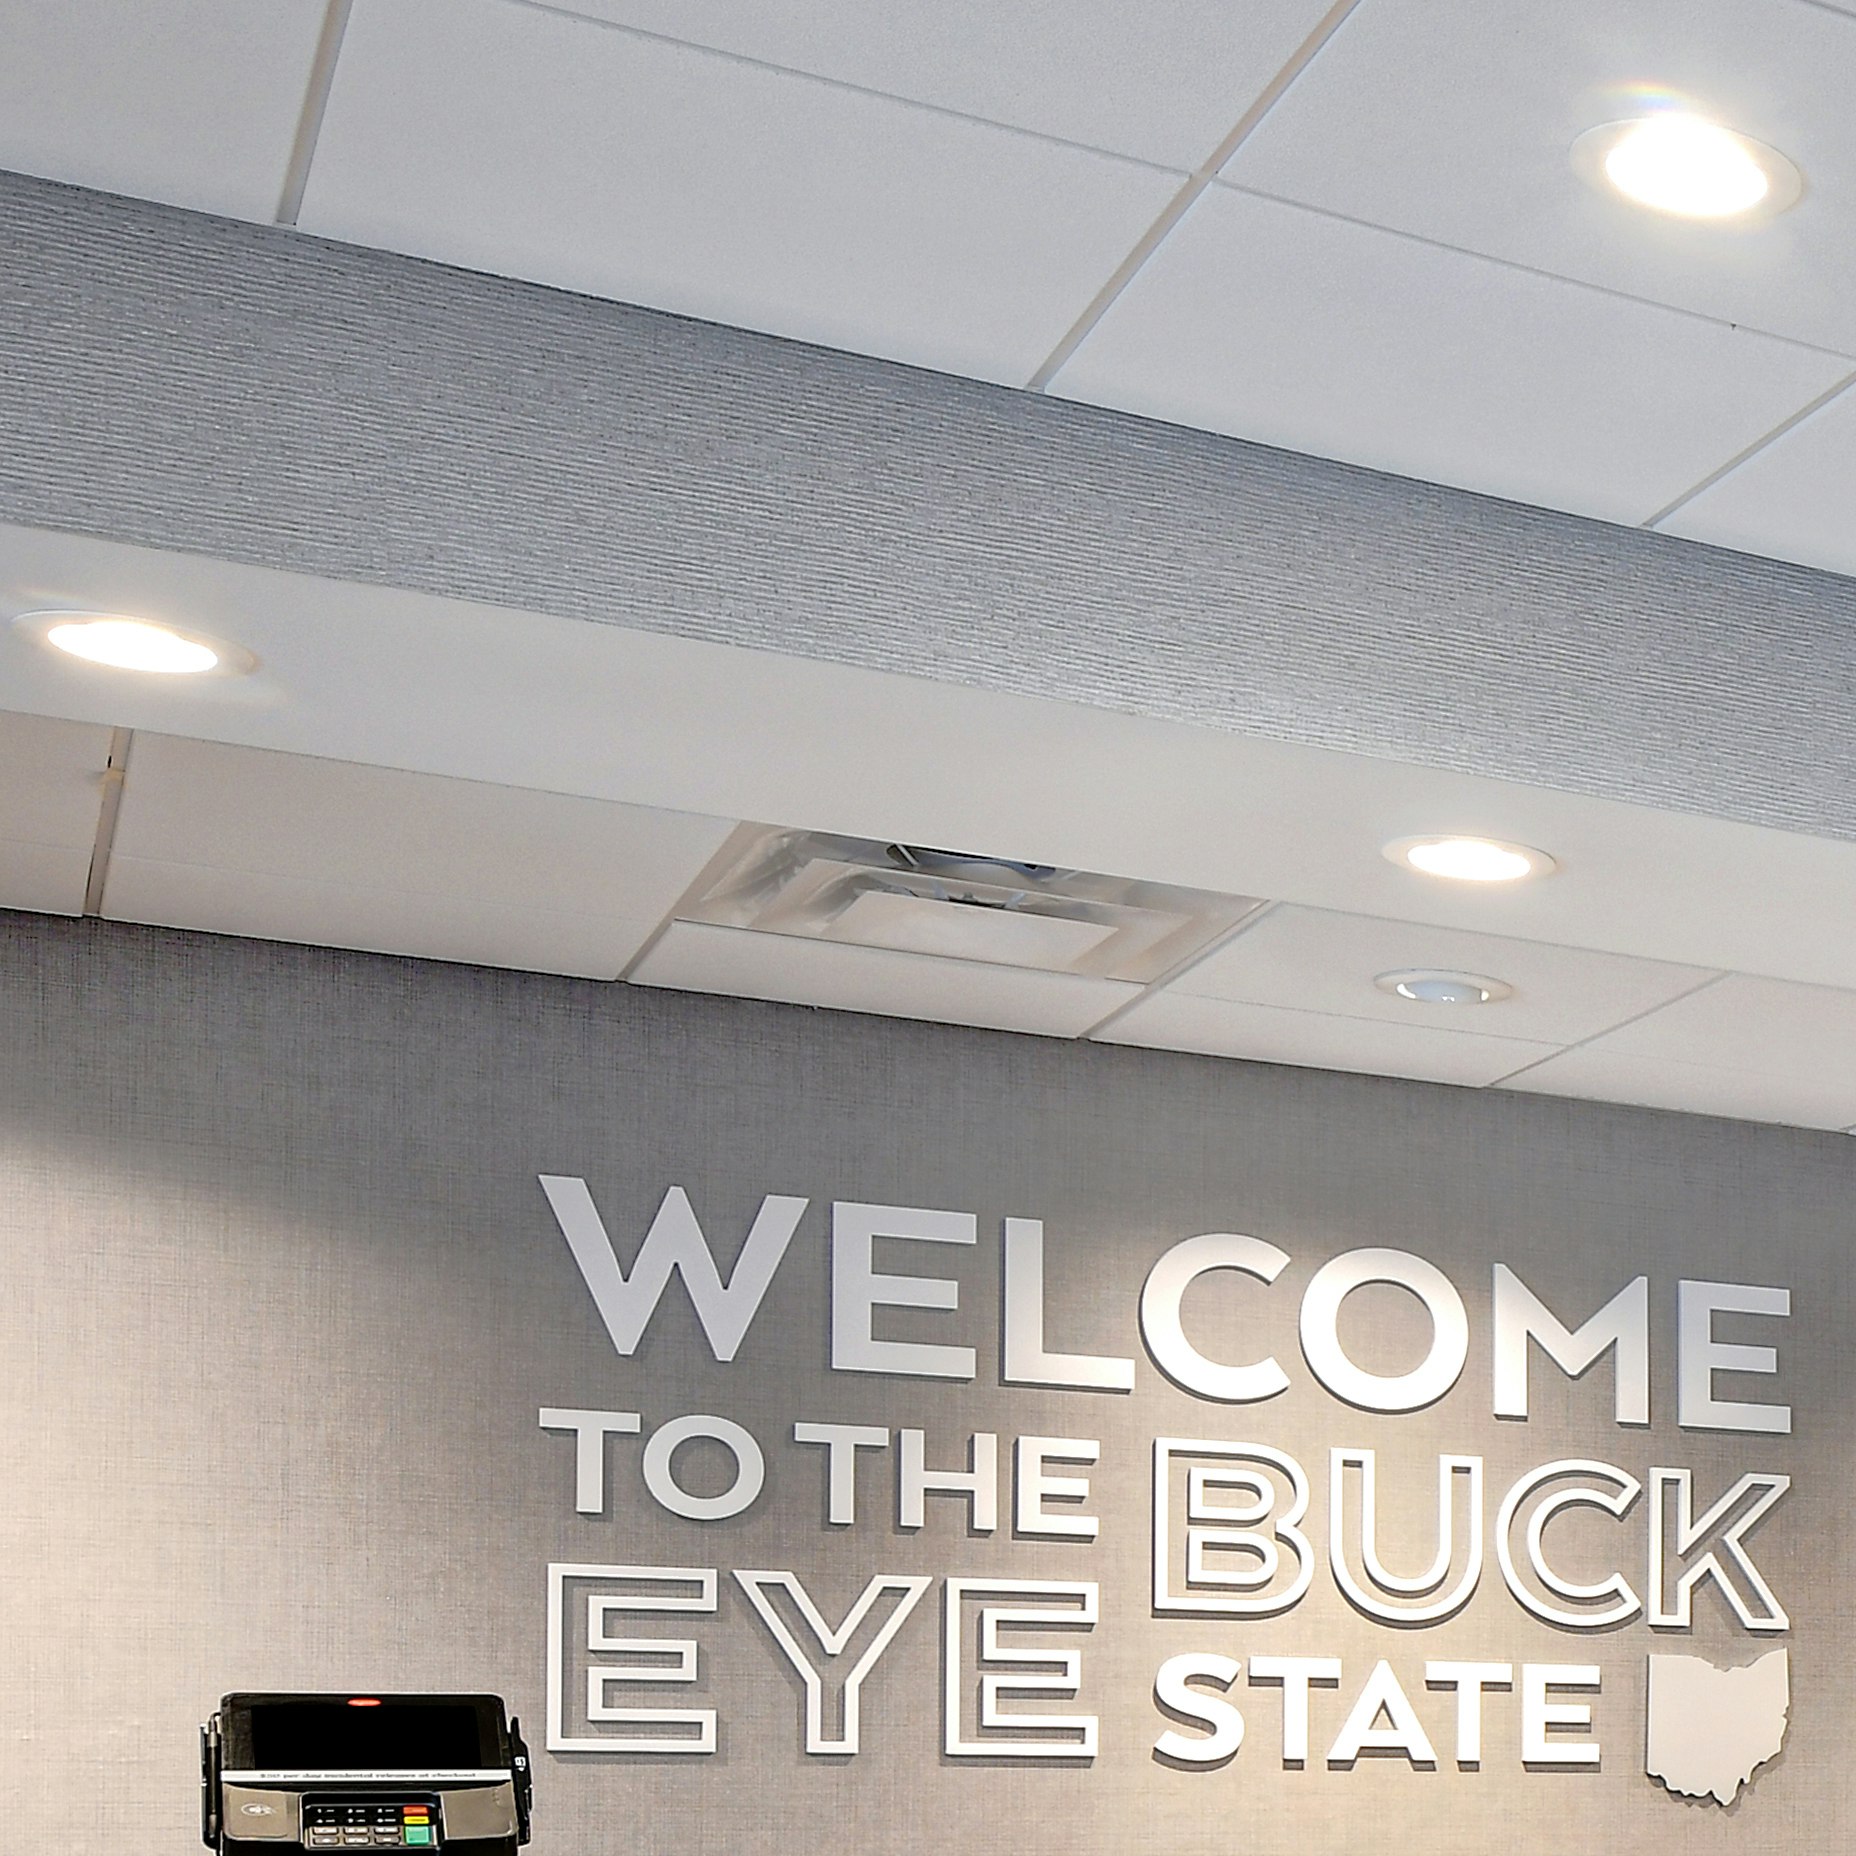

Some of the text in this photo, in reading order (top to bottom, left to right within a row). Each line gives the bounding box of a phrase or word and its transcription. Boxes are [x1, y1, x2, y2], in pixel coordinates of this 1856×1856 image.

[538, 1172, 1792, 1435] WELCOME
[538, 1407, 1792, 1632] TO THE BUCK
[544, 1561, 1603, 1770] EYE STATE
